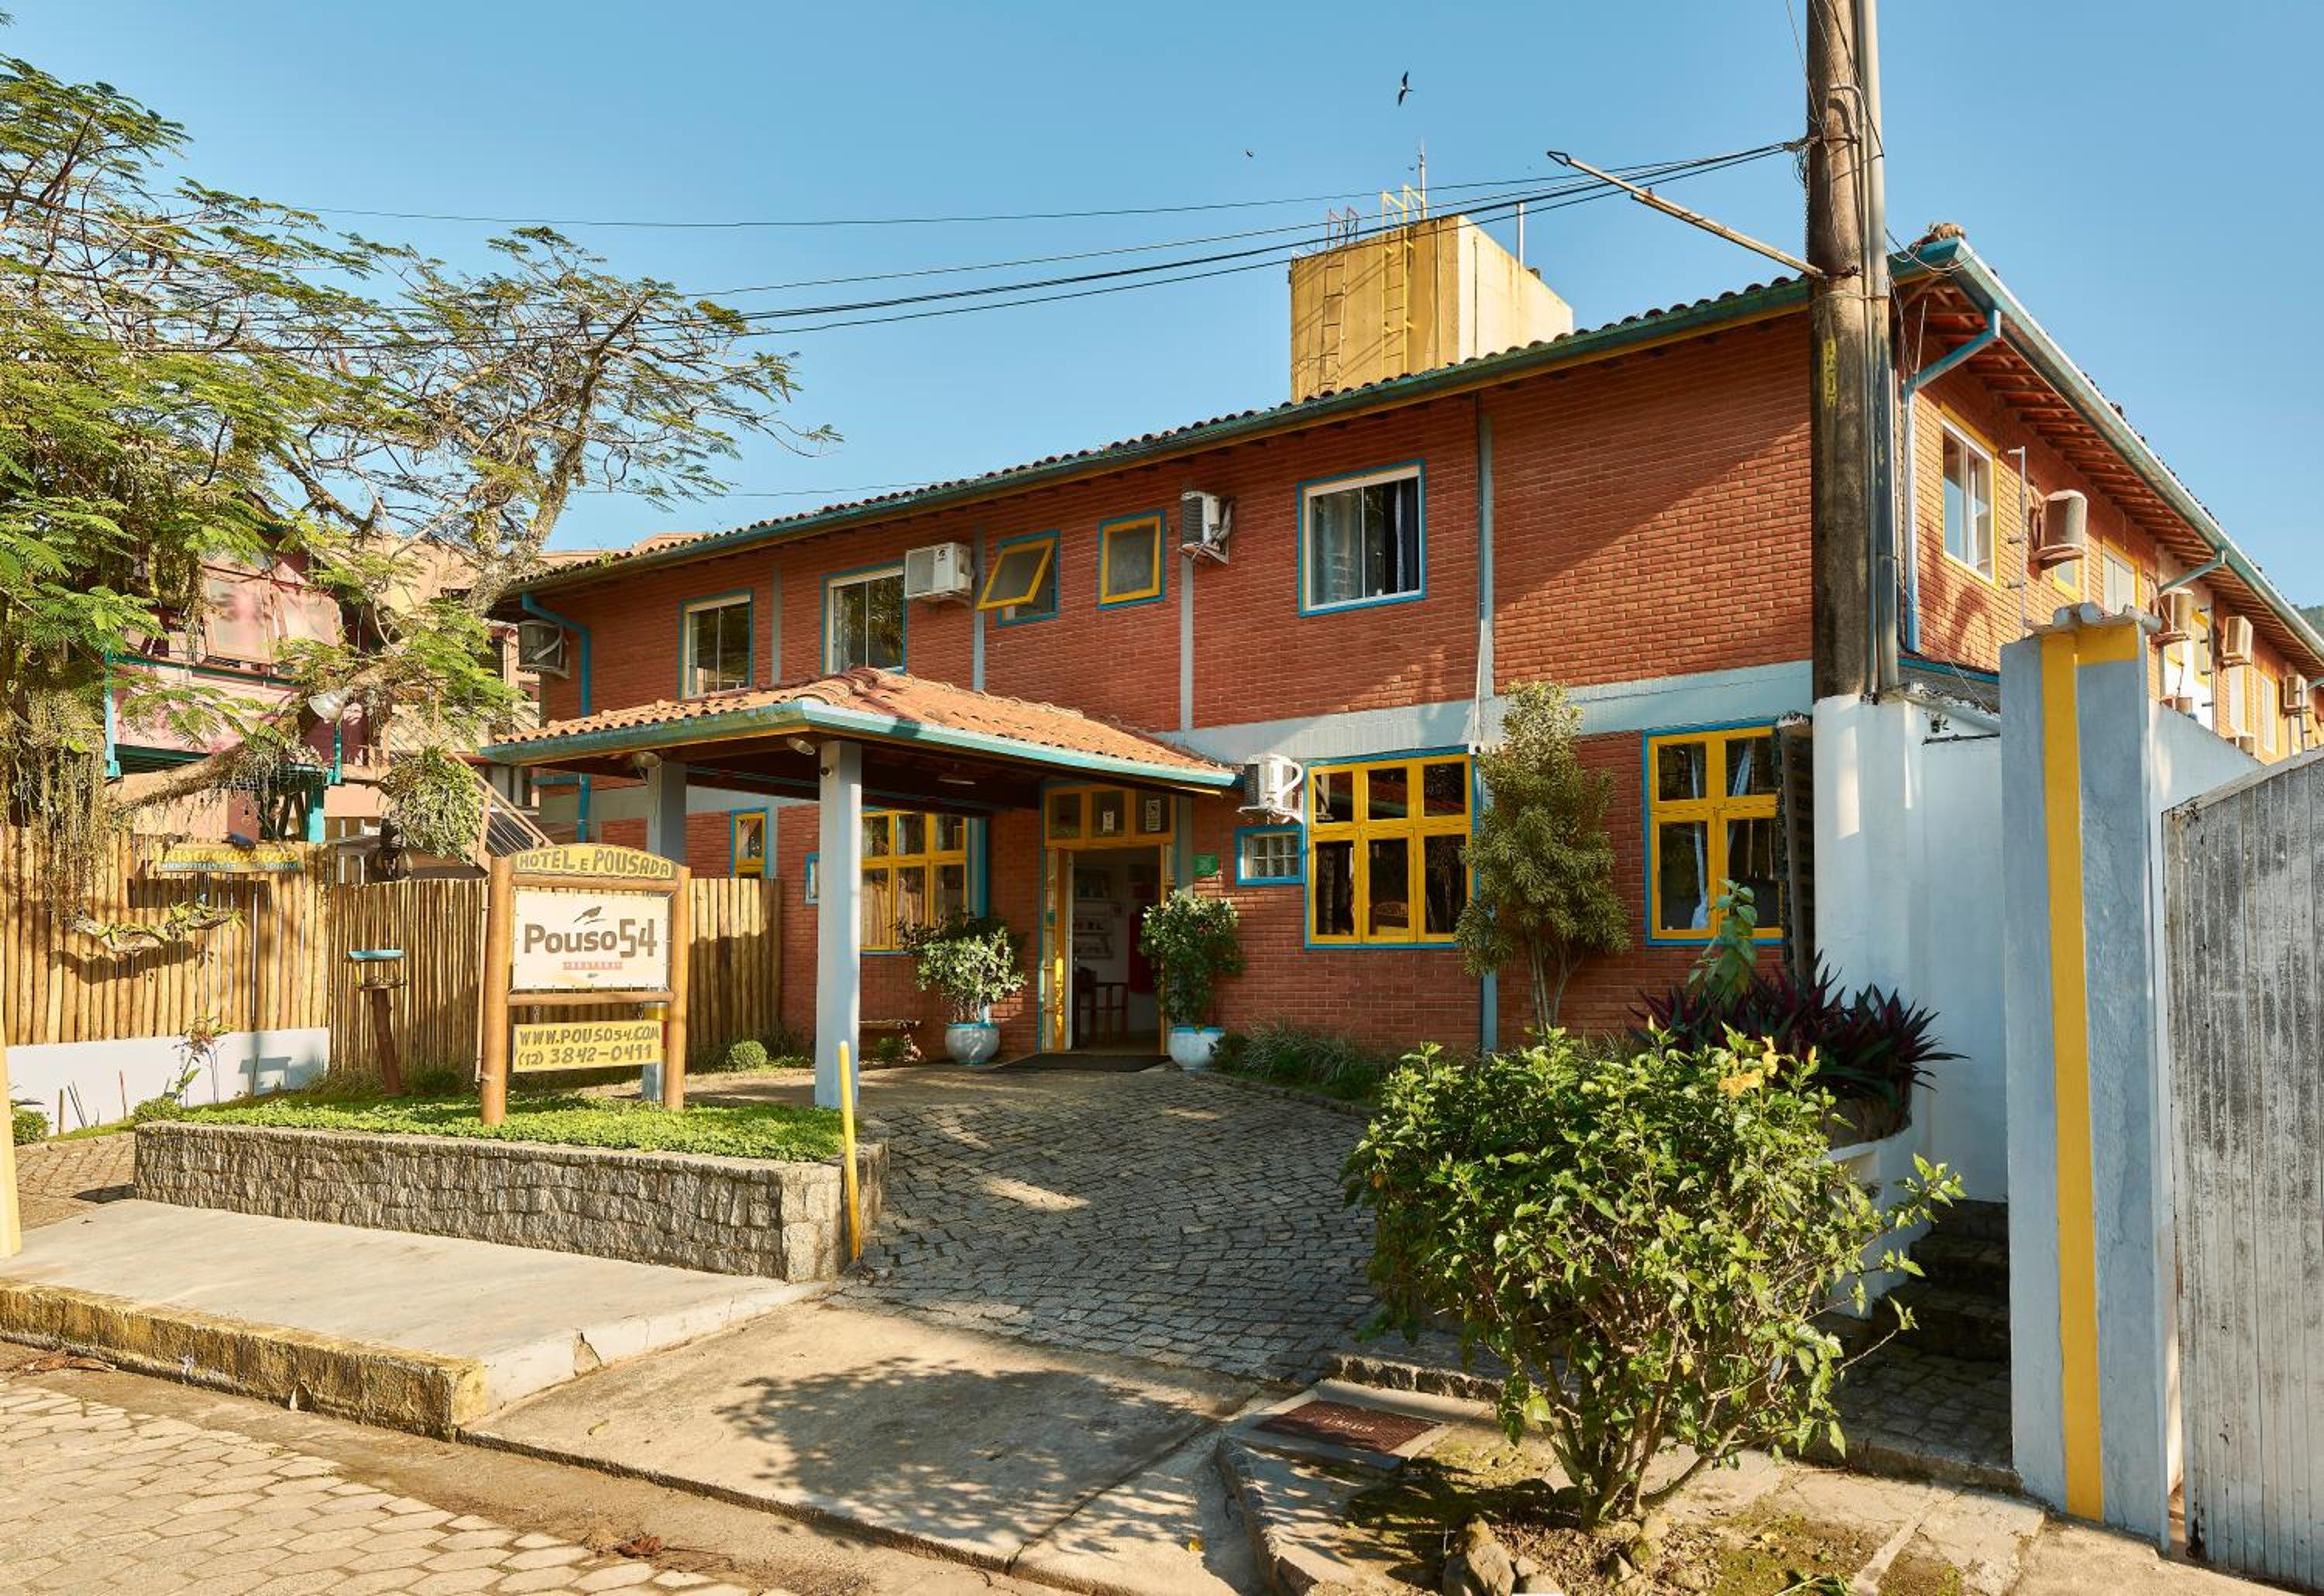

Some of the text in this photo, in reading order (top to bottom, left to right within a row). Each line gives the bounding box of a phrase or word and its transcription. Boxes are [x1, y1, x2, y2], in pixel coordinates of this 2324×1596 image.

[519, 848, 670, 876] HOTEL E POUSADA
[520, 1025, 660, 1046] WWW.POUSO54.COM
[518, 1044, 651, 1067] (12) 3842-0411
